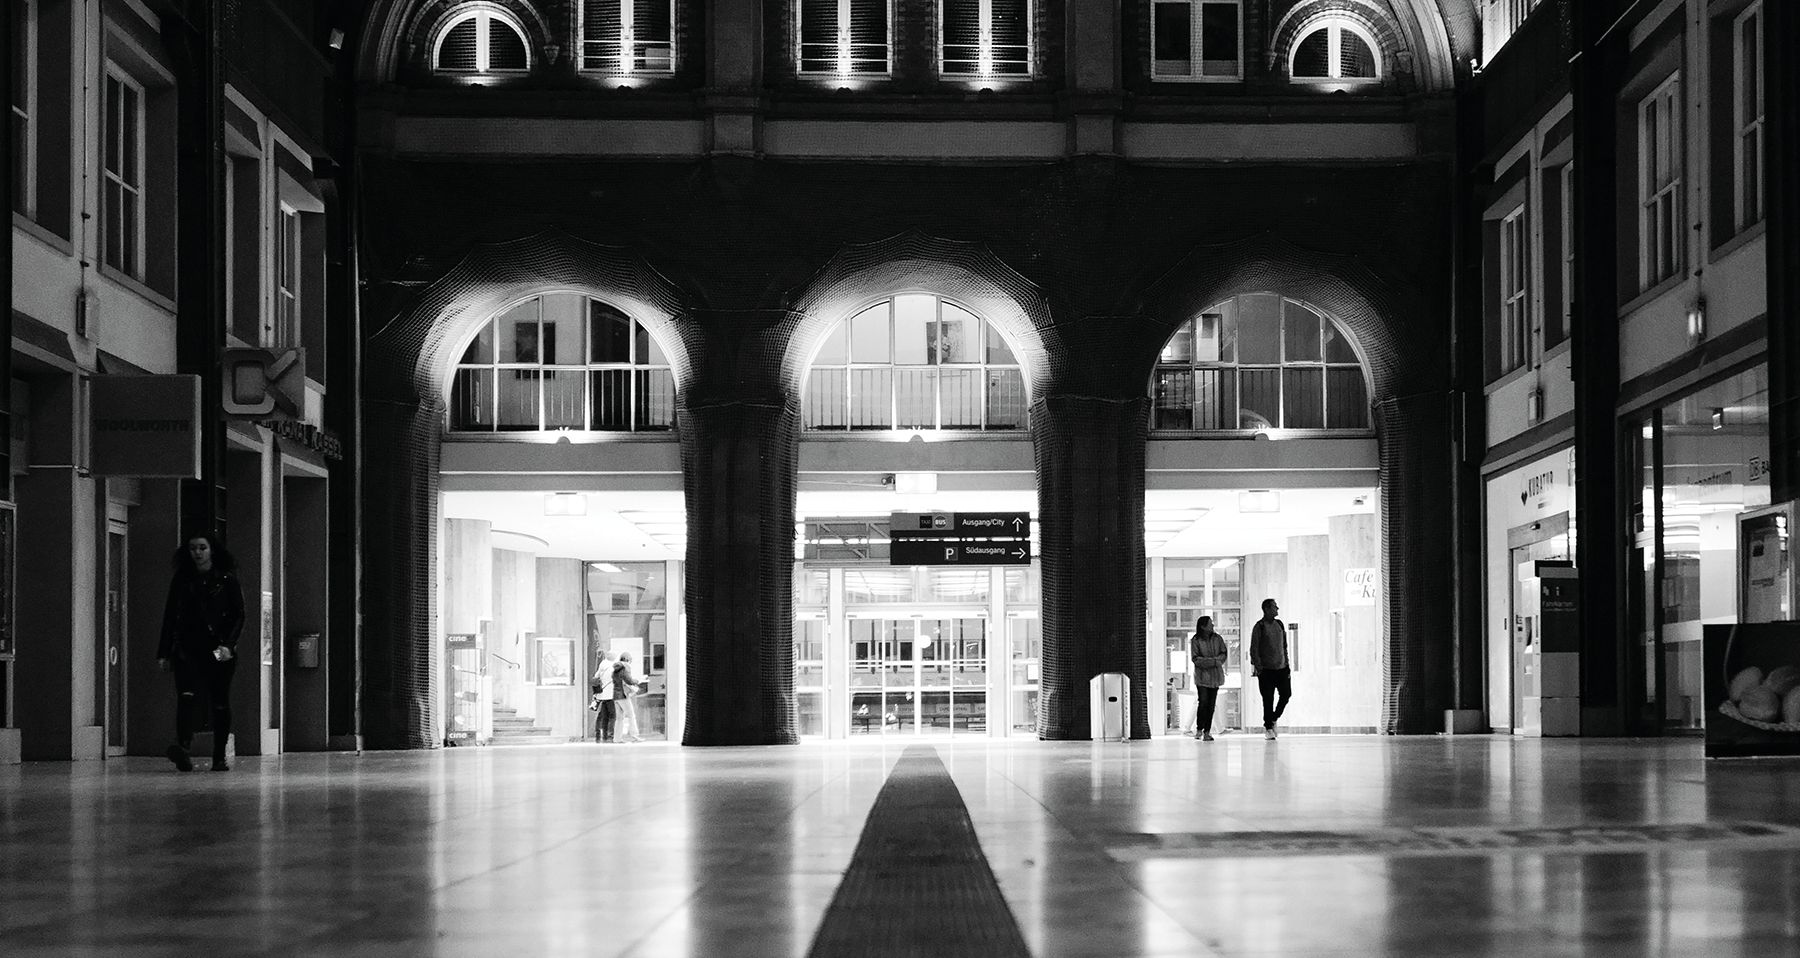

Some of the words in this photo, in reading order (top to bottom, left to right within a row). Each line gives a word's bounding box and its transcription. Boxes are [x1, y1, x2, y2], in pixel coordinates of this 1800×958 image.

[93, 419, 190, 432] WOOLWORTH
[962, 518, 1005, 527] Ausgang/City
[946, 549, 954, 559] P
[965, 546, 1006, 555] Südausgang
